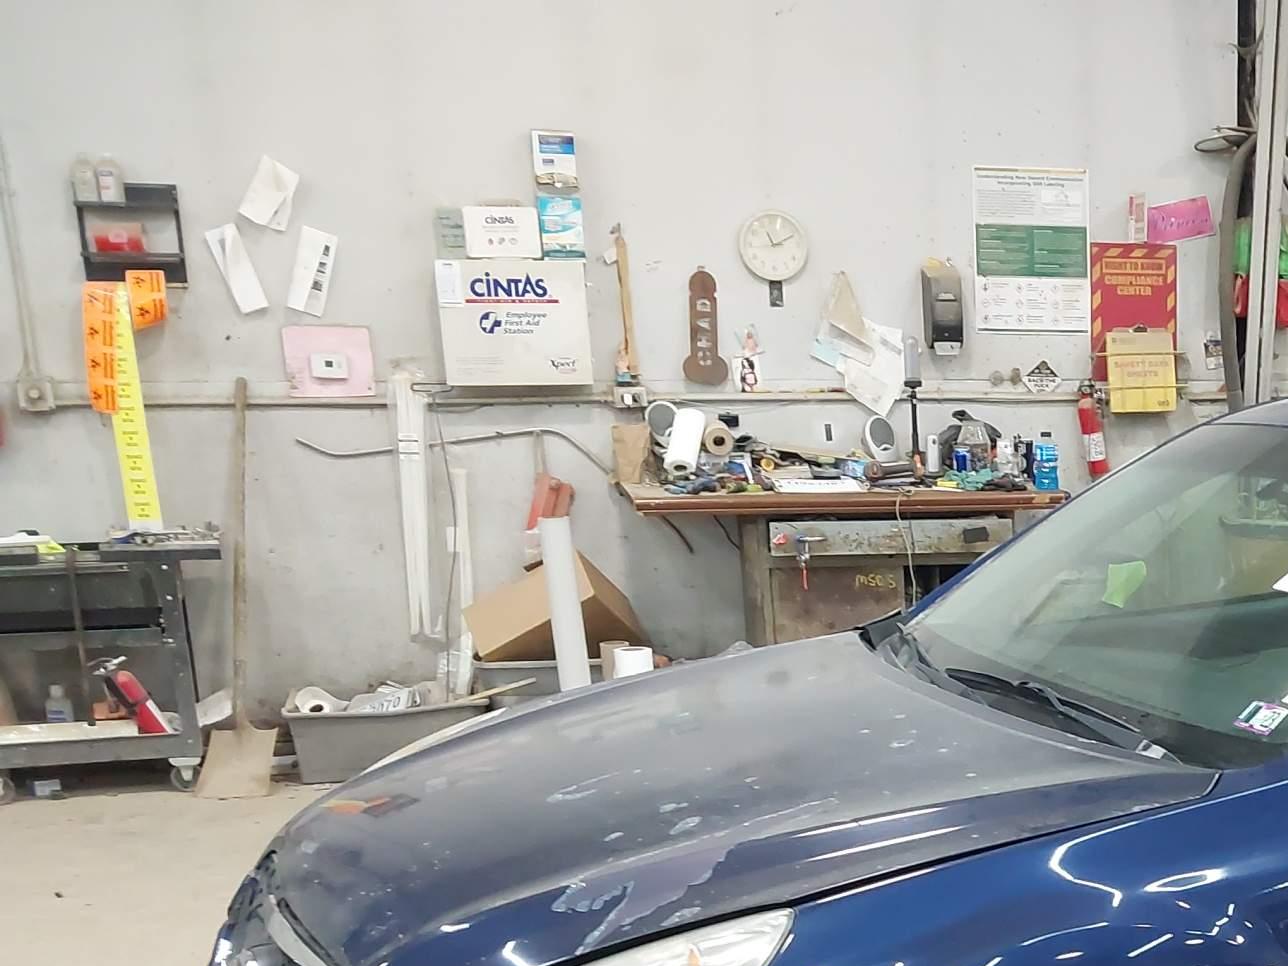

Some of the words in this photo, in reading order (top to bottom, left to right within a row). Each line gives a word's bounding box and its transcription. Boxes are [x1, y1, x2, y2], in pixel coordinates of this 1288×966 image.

[1104, 275, 1164, 286] COMPLIANCE
[1117, 286, 1152, 296] CENTER
[506, 312, 548, 320] Employee
